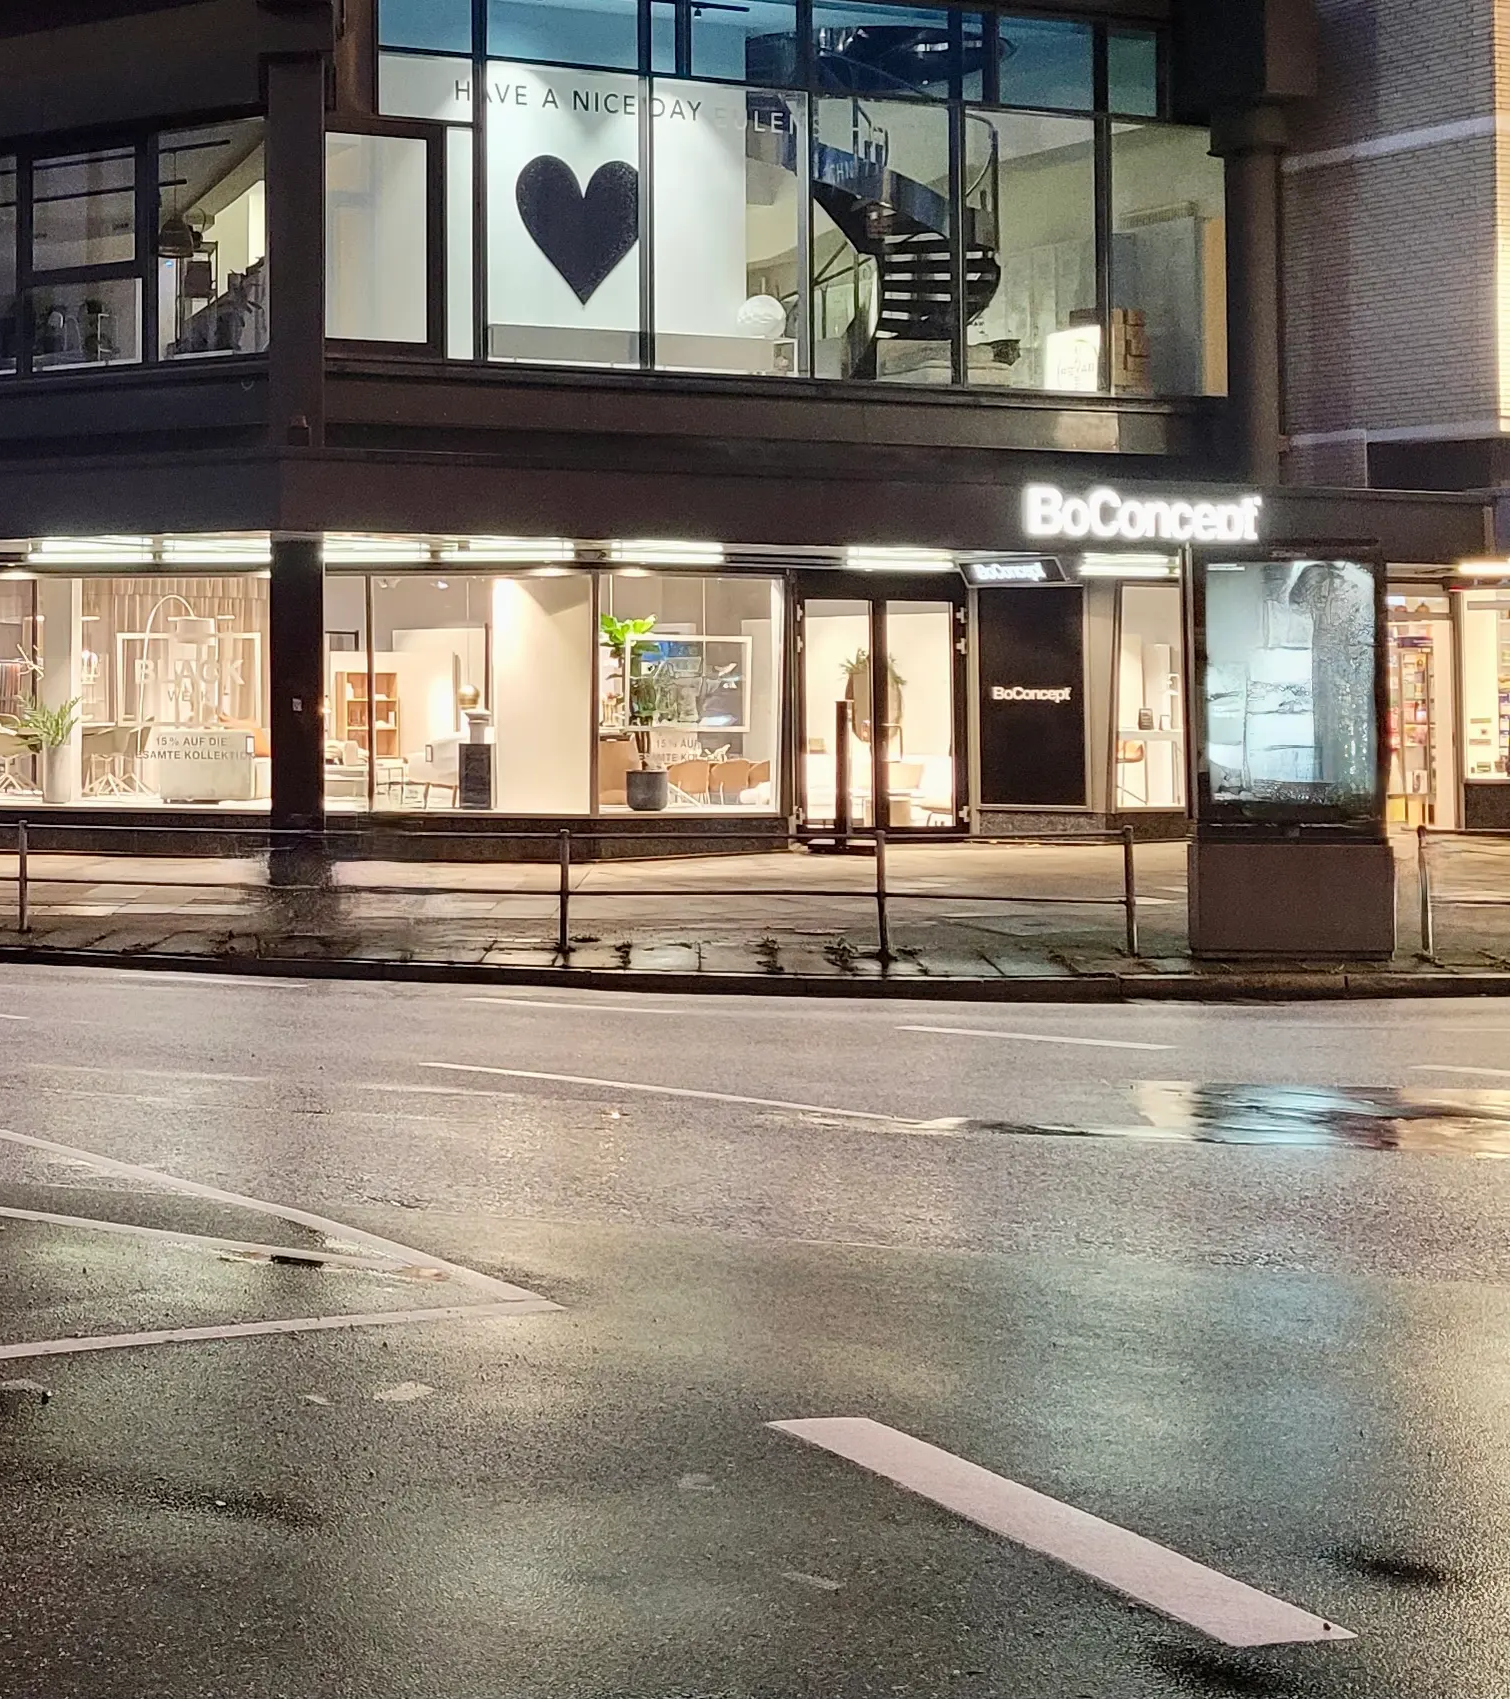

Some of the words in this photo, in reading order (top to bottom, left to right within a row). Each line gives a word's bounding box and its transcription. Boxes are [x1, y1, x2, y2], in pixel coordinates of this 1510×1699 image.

[455, 79, 528, 106] HVE
[542, 88, 559, 109] A
[572, 90, 636, 115] NICE
[650, 97, 702, 121] DAY
[134, 659, 245, 686] BLACK
[992, 686, 1072, 703] BoConcept
[182, 736, 206, 747] AUF
[209, 737, 227, 747] DIE
